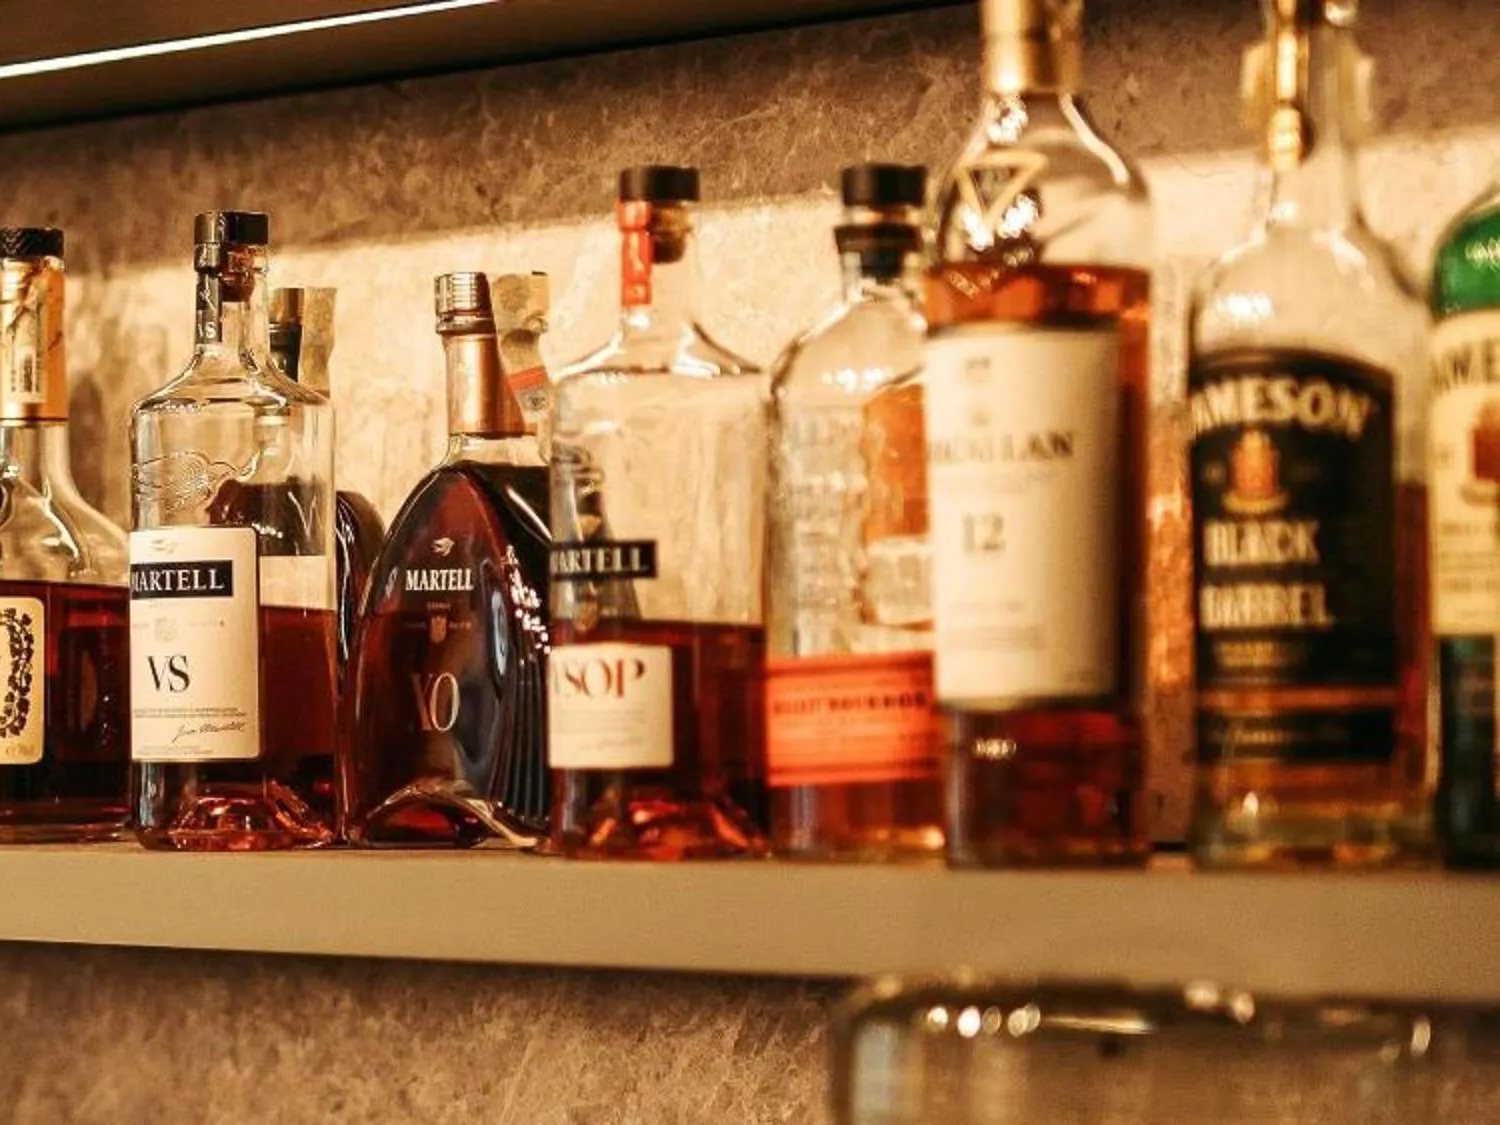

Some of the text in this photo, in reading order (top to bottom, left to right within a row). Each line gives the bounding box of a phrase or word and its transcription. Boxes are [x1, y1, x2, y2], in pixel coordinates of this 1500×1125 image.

[1189, 373, 1371, 440] AMESON
[963, 513, 1006, 553] 12
[1203, 519, 1321, 567] BLACK
[405, 567, 474, 591] MARTELL
[147, 654, 190, 693] VS
[412, 672, 461, 732] XO
